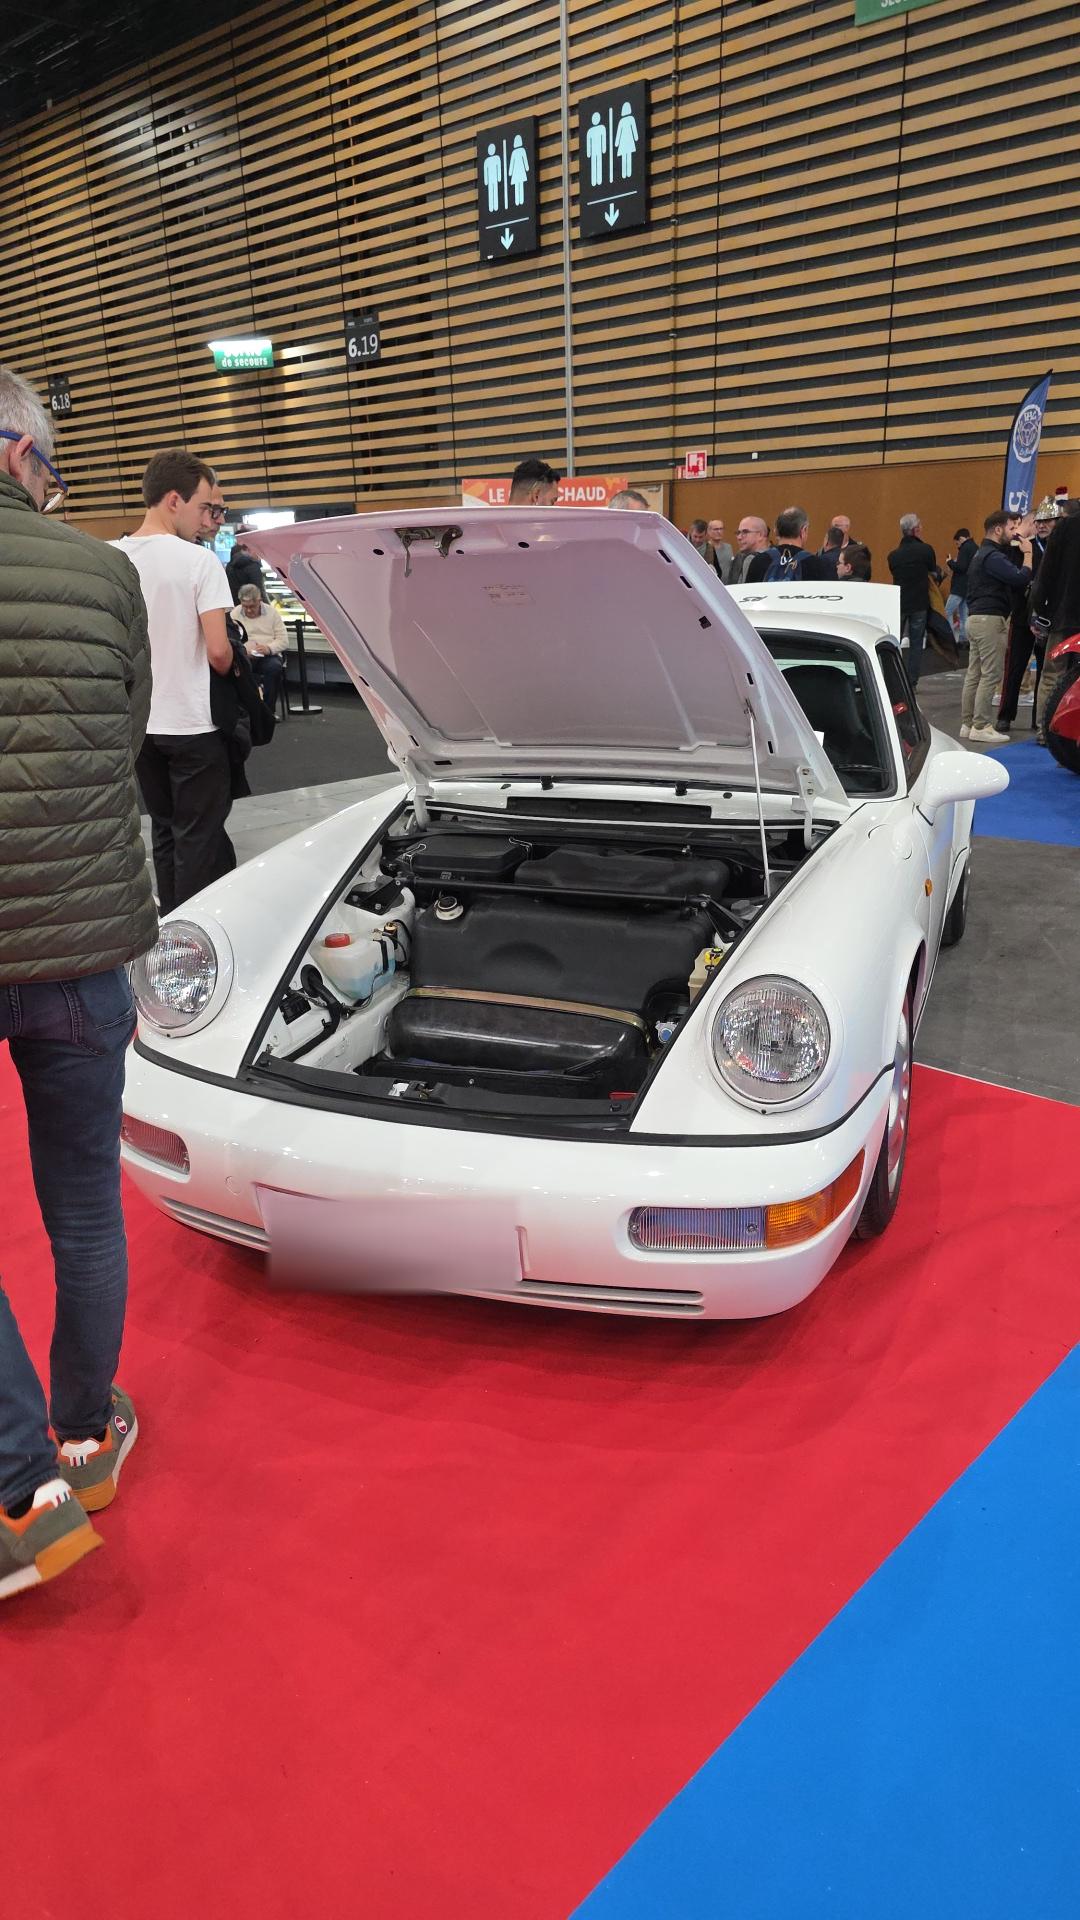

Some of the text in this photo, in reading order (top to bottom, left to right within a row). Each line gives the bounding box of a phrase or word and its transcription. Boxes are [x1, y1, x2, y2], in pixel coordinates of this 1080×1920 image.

[348, 333, 379, 358] 6.19
[221, 357, 268, 367] de secours
[51, 392, 71, 411] 6.18
[488, 487, 505, 503] LE
